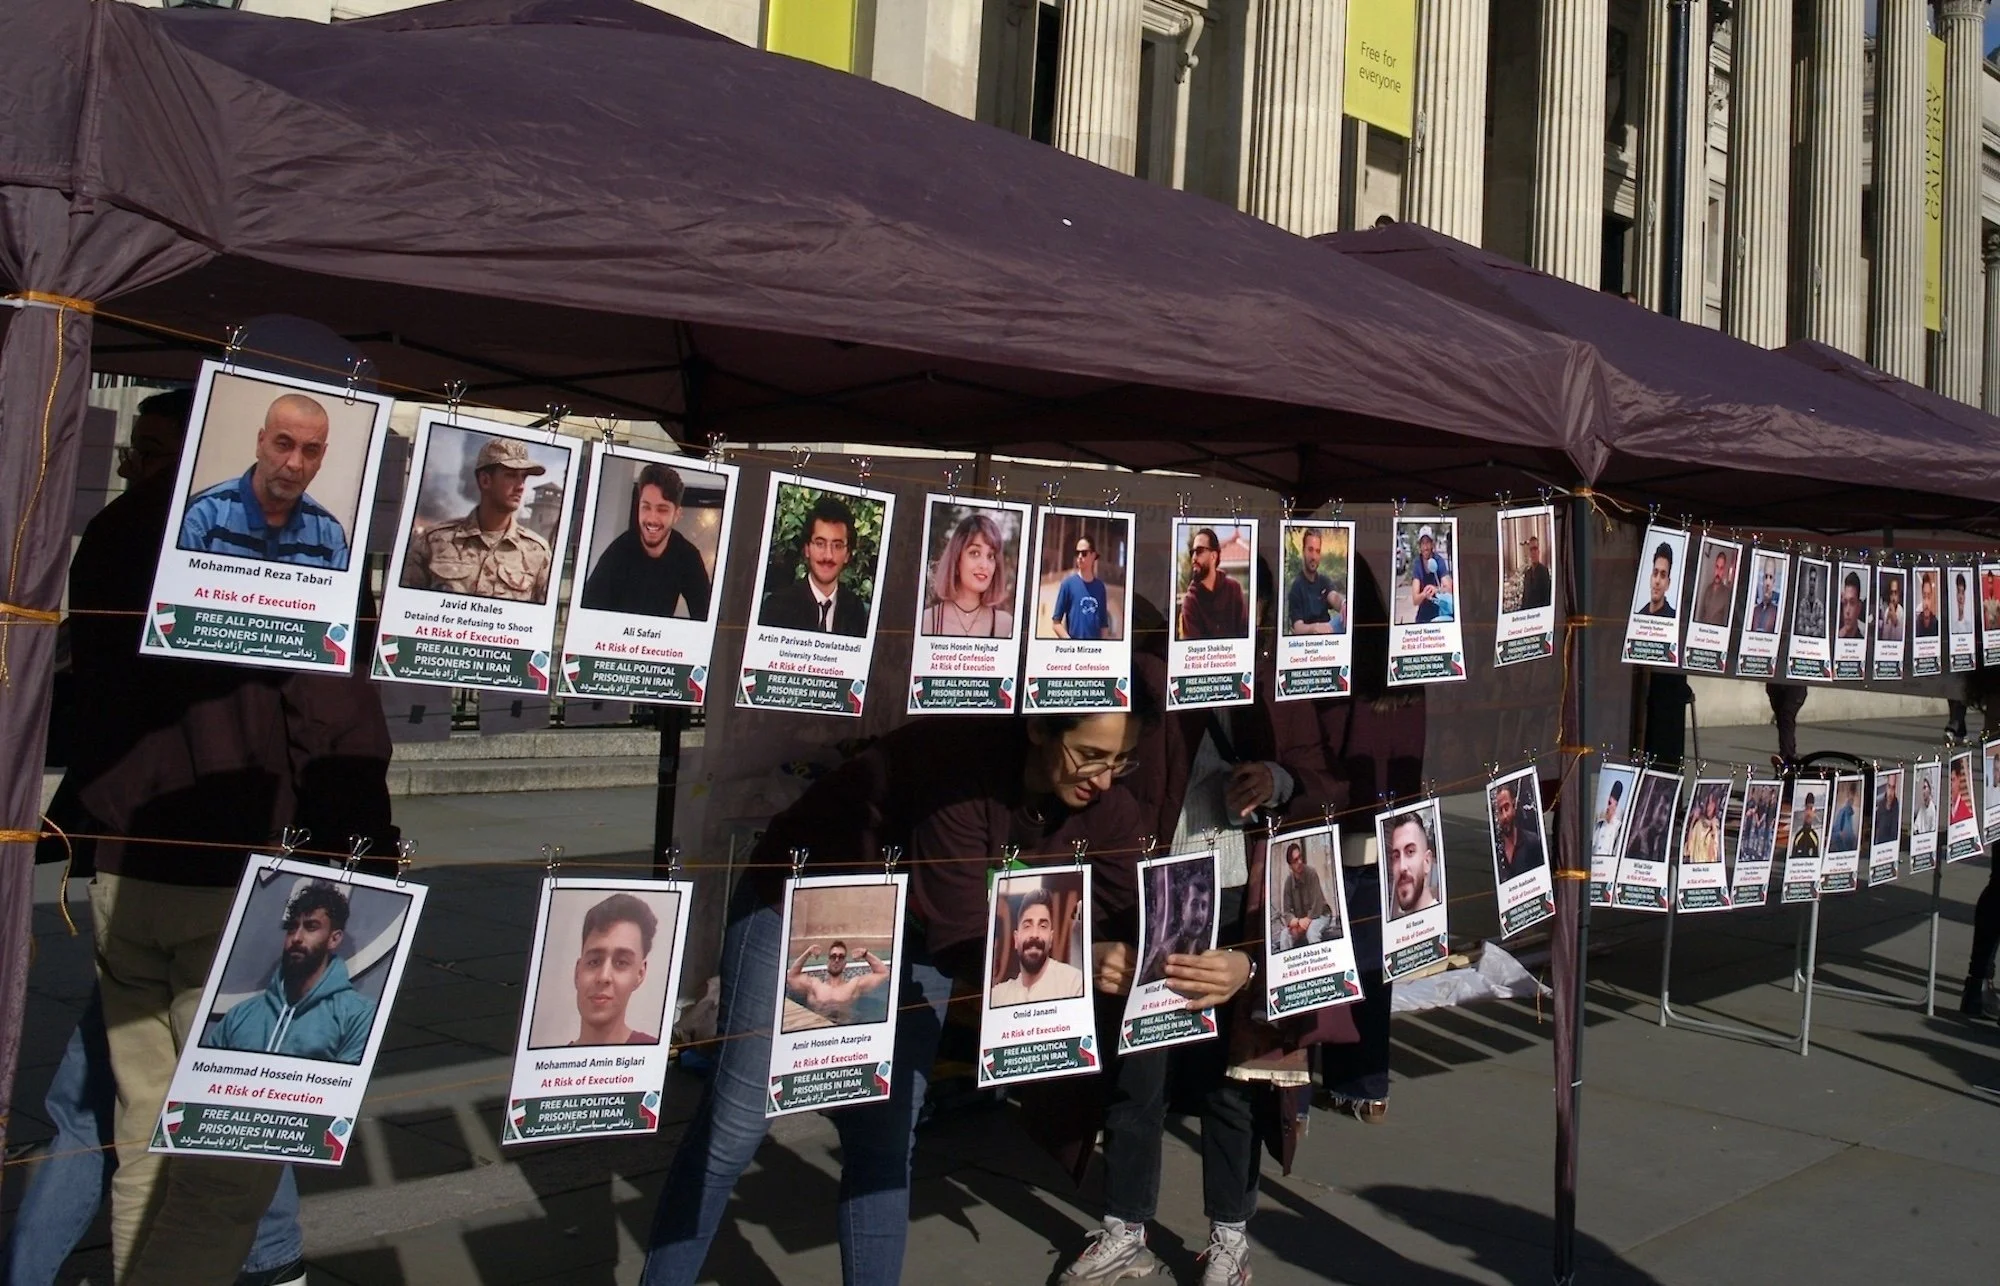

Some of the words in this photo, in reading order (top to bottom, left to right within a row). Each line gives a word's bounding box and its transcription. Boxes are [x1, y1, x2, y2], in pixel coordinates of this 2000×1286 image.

[1361, 41, 1380, 62] Free
[1383, 50, 1397, 68] for
[1359, 67, 1401, 93] everyone
[1931, 85, 1941, 220] GALLERY
[188, 558, 260, 576] Mohammad
[264, 568, 291, 580] Reza
[295, 572, 332, 585] Tabari
[193, 587, 209, 598] At
[211, 589, 238, 602] Risk
[241, 592, 254, 604] of
[257, 594, 316, 611] Execution
[439, 598, 467, 610] Javid
[469, 602, 503, 614] Khales
[194, 612, 223, 624] FREE
[224, 615, 246, 626] ALL
[247, 618, 306, 633] POLITICAL
[404, 610, 439, 622] Detaind
[441, 614, 455, 624] for
[456, 616, 494, 630] Refusing
[496, 622, 505, 630] to
[507, 622, 532, 633] Shoot
[192, 625, 257, 641] PRISONERS
[260, 632, 272, 642] IN
[274, 634, 303, 645] IRAN
[415, 625, 428, 636] At
[430, 627, 452, 638] Risk
[455, 629, 467, 640] of
[469, 631, 519, 645] Execution
[623, 626, 635, 636] Ali
[636, 628, 661, 639] Safari
[415, 642, 440, 653] FREE
[441, 645, 460, 655] ALL
[461, 647, 512, 660] POLITICAL
[594, 641, 606, 651] At
[608, 642, 627, 653] Risk
[629, 644, 639, 654] of
[640, 646, 683, 658] Execution
[758, 633, 779, 643] Artin
[780, 635, 813, 647] Parivash
[814, 640, 861, 652] Dowlatabadi
[929, 642, 948, 650] Venus
[974, 643, 998, 652] Nejhad
[414, 655, 471, 669] PRISONERS
[472, 660, 483, 670] IN
[485, 662, 510, 672] IRAN
[778, 650, 811, 661] University
[812, 653, 837, 663] Student
[1184, 653, 1205, 661] Coerced
[1206, 652, 1236, 660] Confession
[594, 660, 615, 670] FREE
[616, 662, 632, 672] ALL
[633, 663, 676, 675] POLITICAL
[767, 660, 777, 669] At
[779, 661, 795, 671] Risk
[797, 663, 806, 672] of
[807, 665, 844, 676] Execution
[962, 663, 995, 671] Execution
[592, 672, 641, 684] PRISONERS
[642, 676, 651, 685] IN
[652, 677, 673, 686] IRAN
[767, 674, 786, 683] FREE
[786, 676, 800, 685] ALL
[801, 677, 838, 689] POLITICAL
[931, 679, 946, 687] FREE
[946, 679, 957, 687] ALL
[766, 685, 807, 696] PRISONERS
[808, 689, 816, 697] IN
[817, 690, 836, 699] IRAN
[1013, 1010, 1031, 1019] Omid
[1033, 1006, 1056, 1016] Janami
[1001, 1031, 1009, 1039] At
[1011, 1029, 1024, 1038] Risk
[1026, 1028, 1034, 1036] of
[1036, 1023, 1070, 1034] Execution
[792, 1040, 809, 1051] Amir
[810, 1036, 838, 1048] Hossein
[840, 1032, 871, 1046] Azarpira
[1003, 1048, 1019, 1057] FREE
[1020, 1046, 1032, 1054] ALL
[1033, 1041, 1067, 1053] POLITICAL
[534, 1058, 587, 1070] Mohammad
[589, 1057, 613, 1067] Amin
[615, 1056, 645, 1068] Biglari
[793, 1059, 801, 1069] At
[803, 1057, 818, 1067] Risk
[820, 1056, 829, 1065] of
[831, 1050, 868, 1063] Execution
[1003, 1054, 1040, 1066] PRISONERS
[1041, 1053, 1049, 1061] IN
[1050, 1050, 1068, 1060] IRAN
[191, 1060, 259, 1077] Mohammad
[259, 1067, 304, 1082] Hossein
[304, 1073, 353, 1088] Hosseini
[541, 1079, 552, 1088] At
[554, 1077, 573, 1087] Risk
[575, 1076, 585, 1086] of
[587, 1074, 634, 1085] Execution
[793, 1074, 810, 1084] FREE
[811, 1072, 824, 1082] ALL
[825, 1067, 862, 1080] POLITICAL
[207, 1083, 223, 1094] At
[223, 1084, 250, 1097] Risk
[250, 1087, 265, 1098] of
[266, 1088, 325, 1104] Execution
[793, 1082, 832, 1095] PRISONERS
[833, 1081, 841, 1089] IN
[843, 1078, 861, 1088] IRAN
[539, 1100, 561, 1110] FREE
[562, 1099, 579, 1108] ALL
[580, 1096, 626, 1107] POLITICAL
[201, 1109, 230, 1120] FREE
[229, 1111, 252, 1122] ALL
[252, 1113, 310, 1127] POLITICAL
[538, 1110, 588, 1122] PRISONERS
[589, 1109, 599, 1118] IN
[600, 1108, 623, 1117] IRAN
[197, 1123, 261, 1137] PRISONERS
[261, 1128, 275, 1138] IN
[275, 1129, 305, 1141] IRAN
